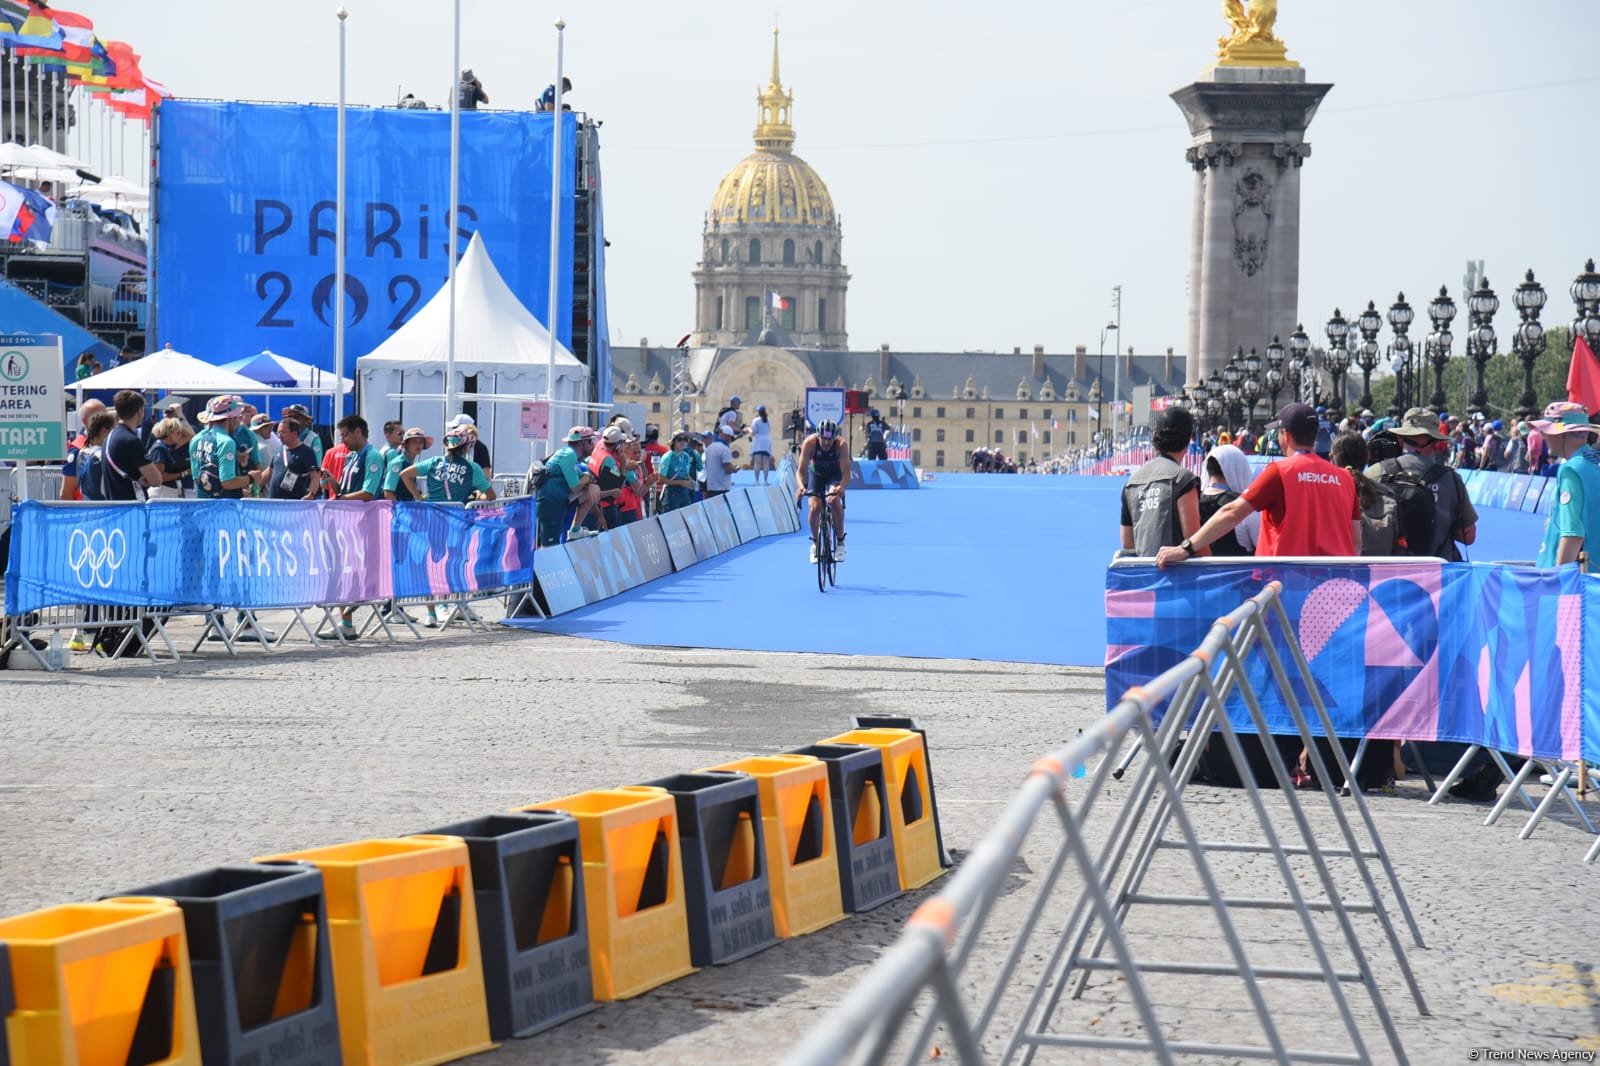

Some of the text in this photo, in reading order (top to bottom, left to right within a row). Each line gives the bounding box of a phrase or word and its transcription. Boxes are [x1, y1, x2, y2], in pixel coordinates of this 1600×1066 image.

[256, 271, 448, 331] 202
[0, 385, 47, 396] TERING
[0, 399, 31, 410] AREA
[0, 427, 47, 446] TART
[1297, 472, 1342, 486] MEDICAL
[1139, 497, 1160, 511] 305
[302, 529, 366, 576] 2024
